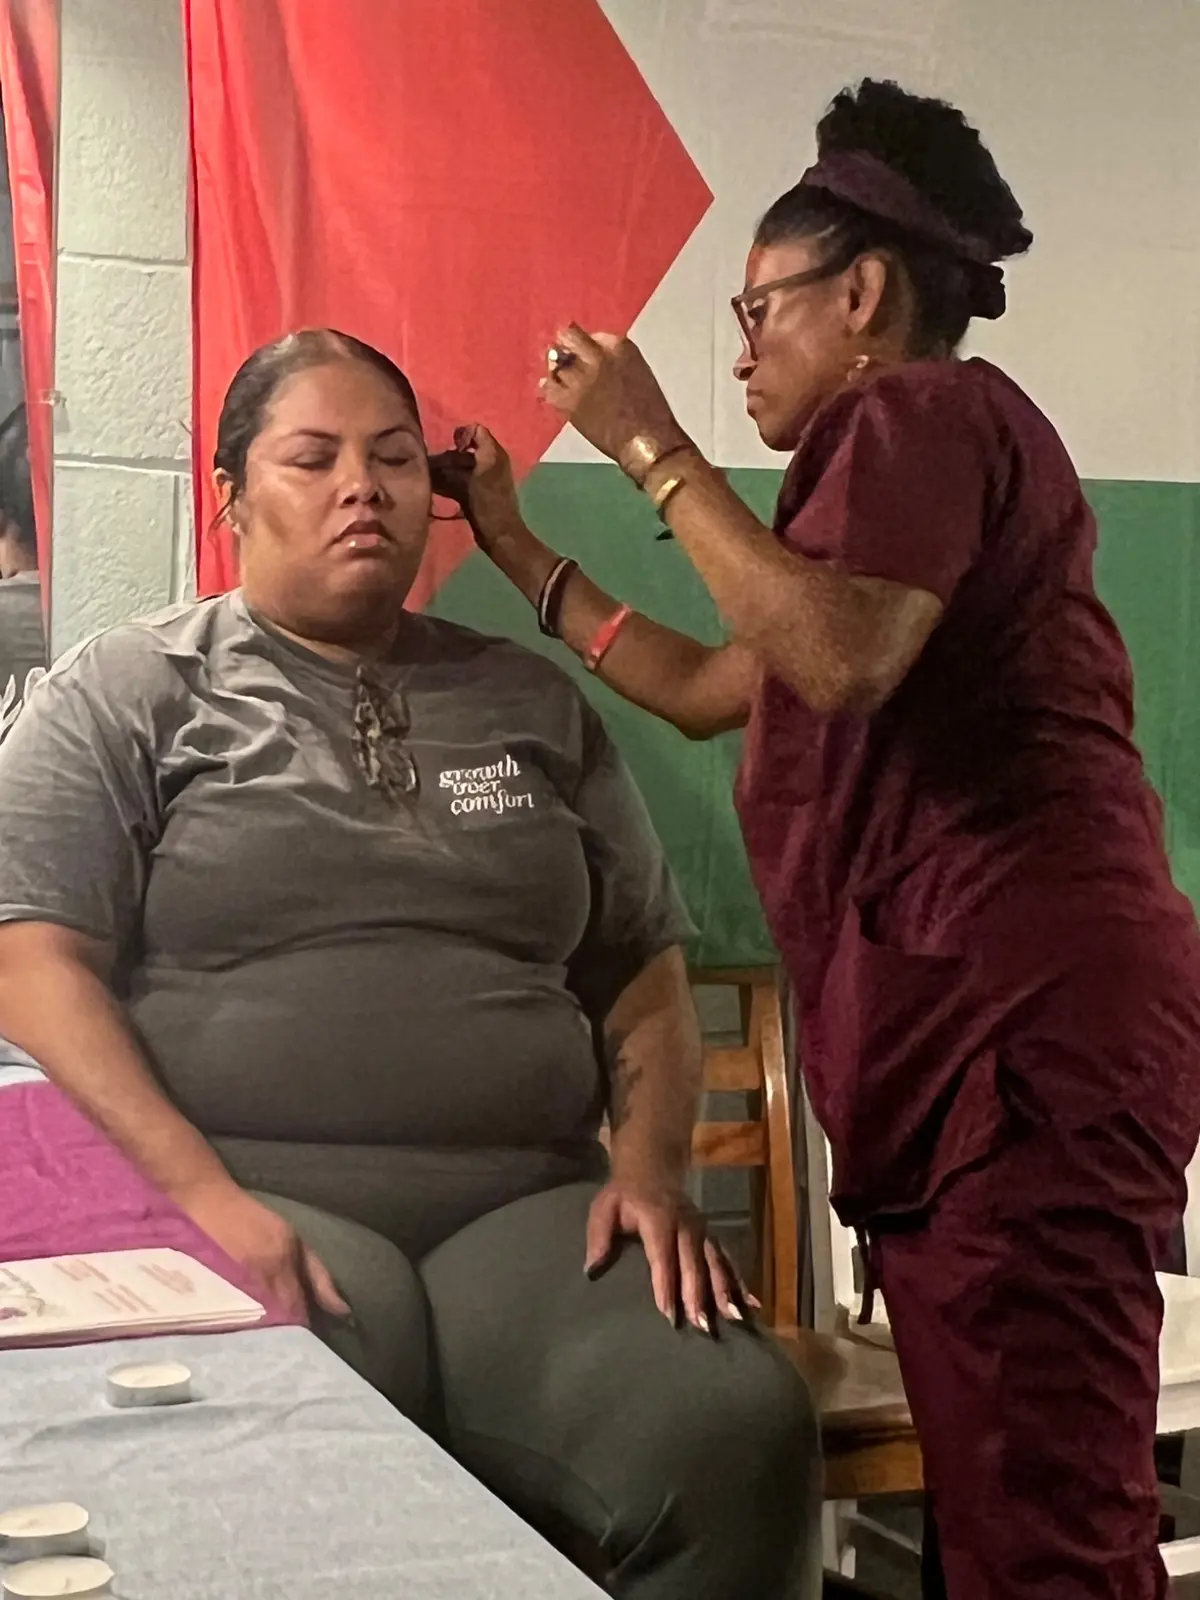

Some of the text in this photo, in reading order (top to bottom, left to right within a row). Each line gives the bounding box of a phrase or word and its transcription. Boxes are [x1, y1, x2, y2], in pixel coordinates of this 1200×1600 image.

[439, 753, 521, 788] growth
[450, 788, 535, 816] comfort
[453, 780, 501, 796] over
